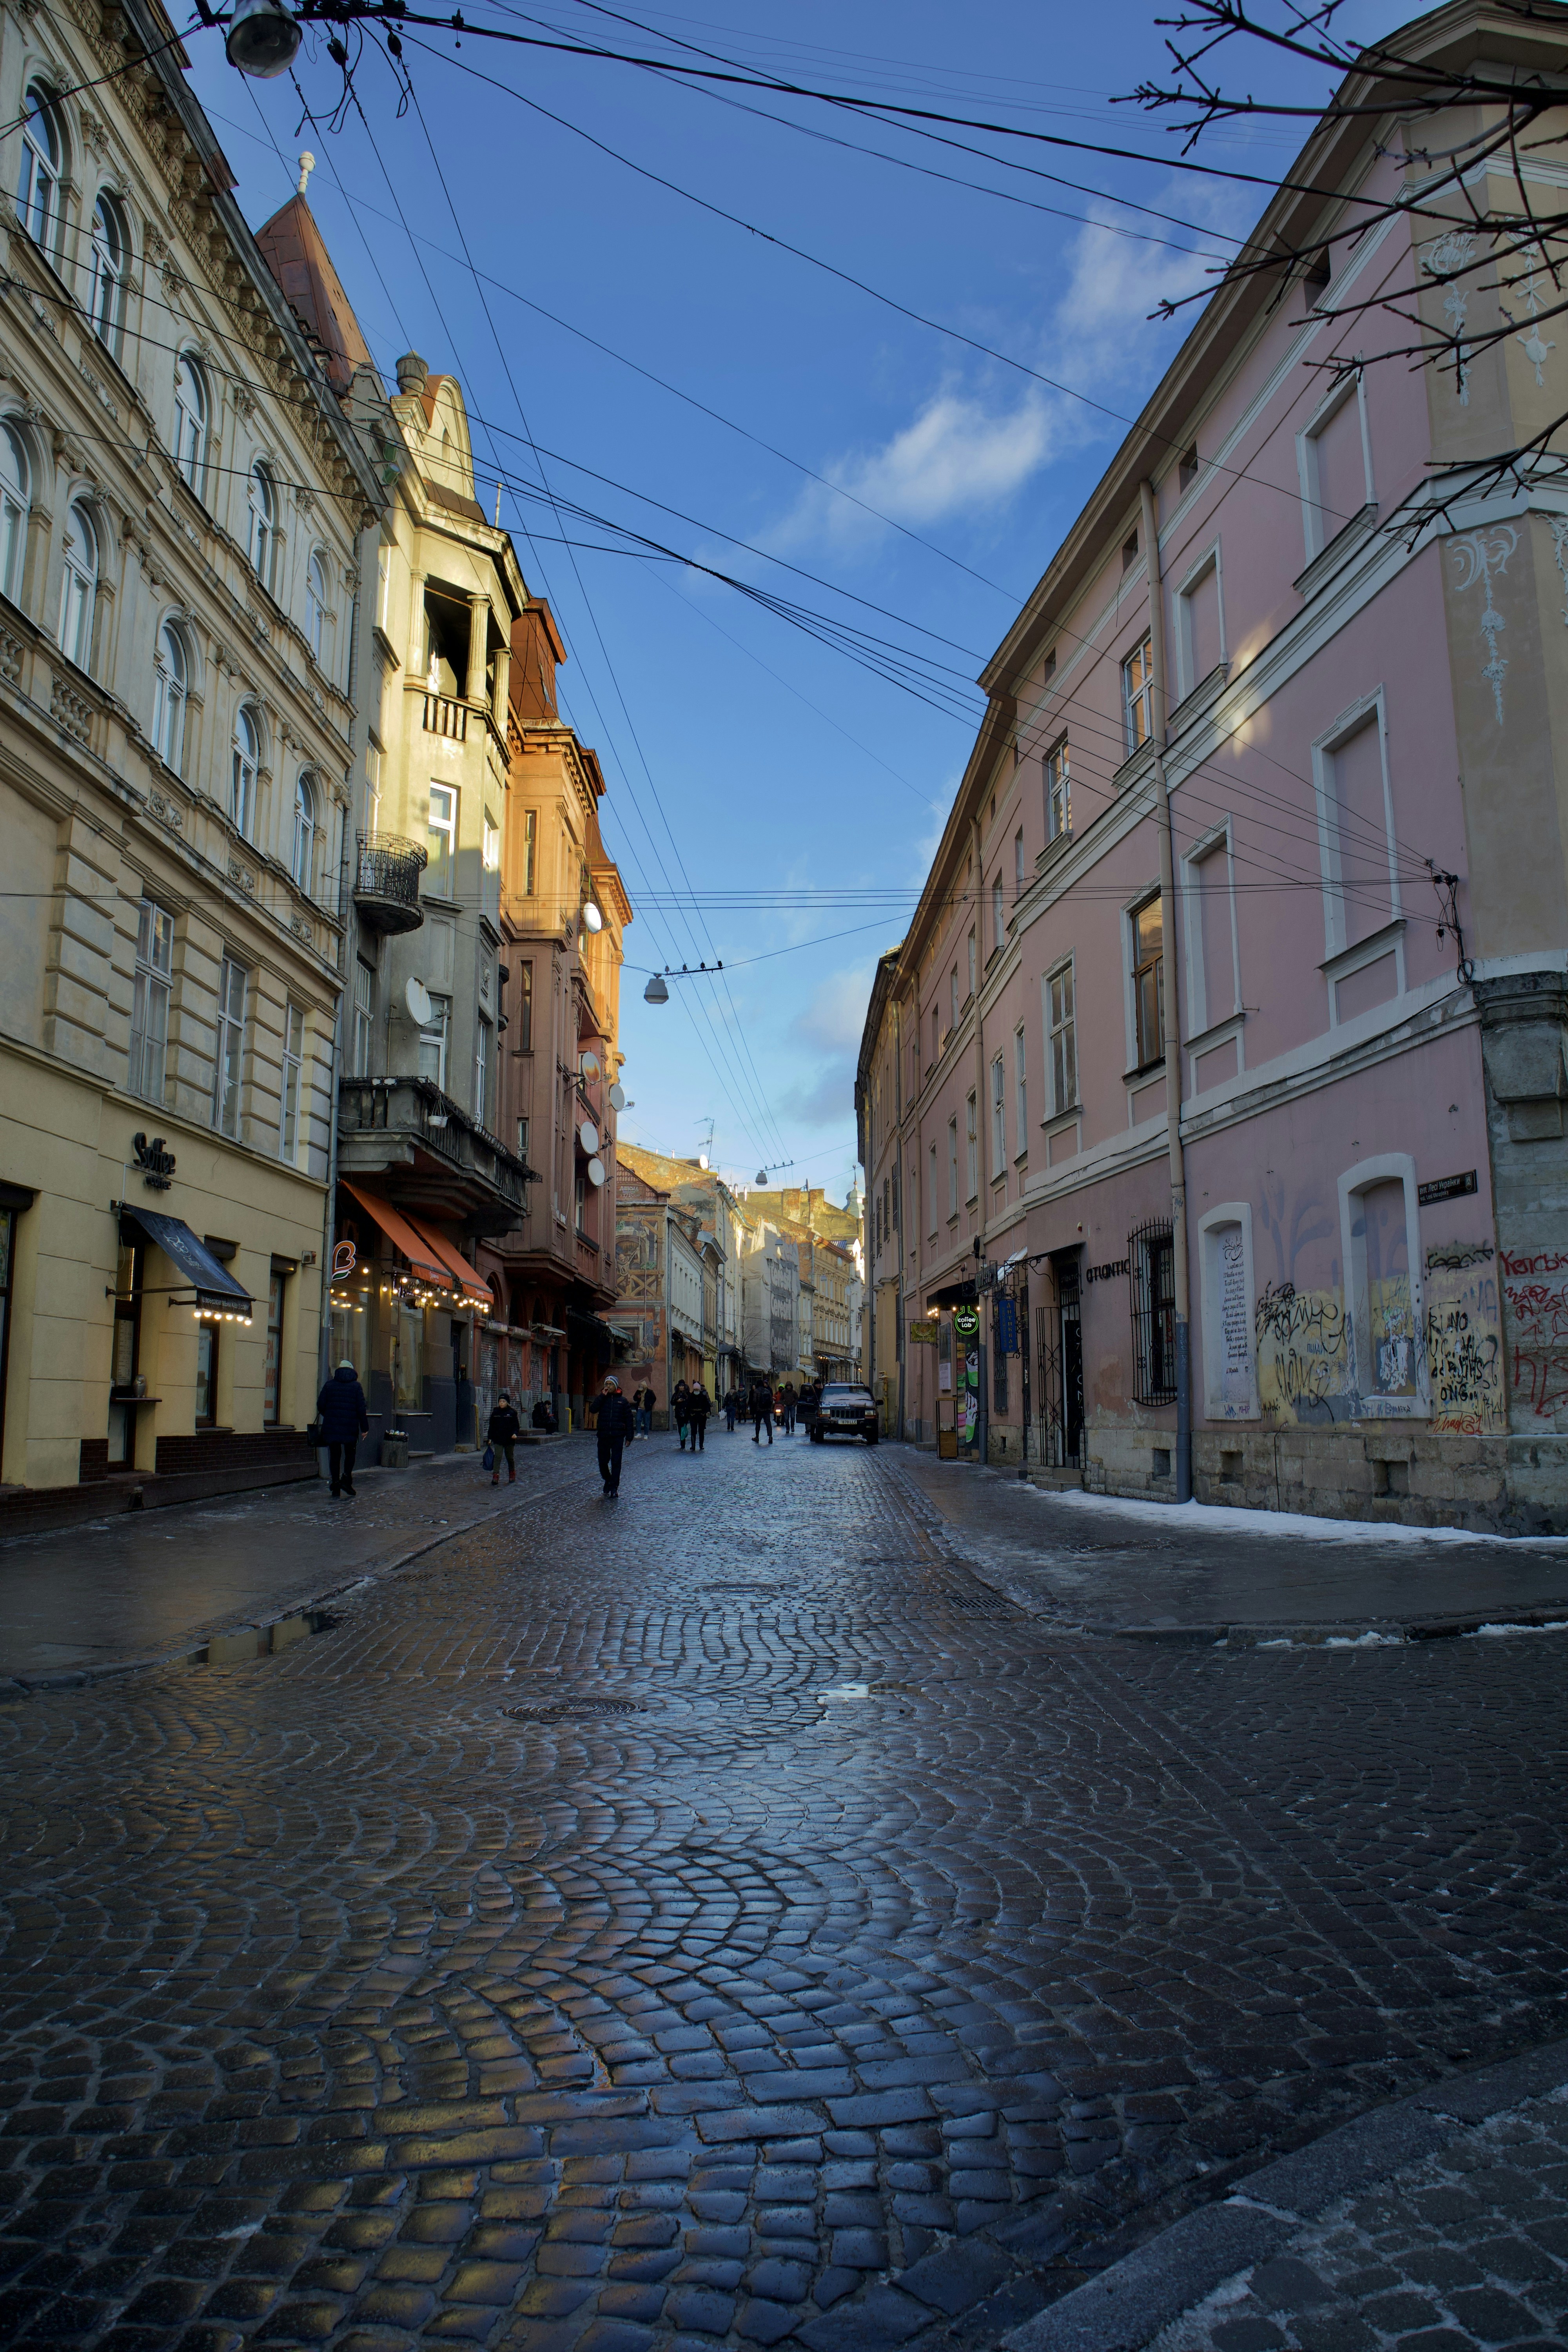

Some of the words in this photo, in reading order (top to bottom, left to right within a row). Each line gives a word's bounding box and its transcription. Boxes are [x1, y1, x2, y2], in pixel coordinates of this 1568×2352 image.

[133, 1132, 176, 1174] Soffee
[1428, 1182, 1438, 1192] Лесі
[1438, 1178, 1460, 1190] Українки
